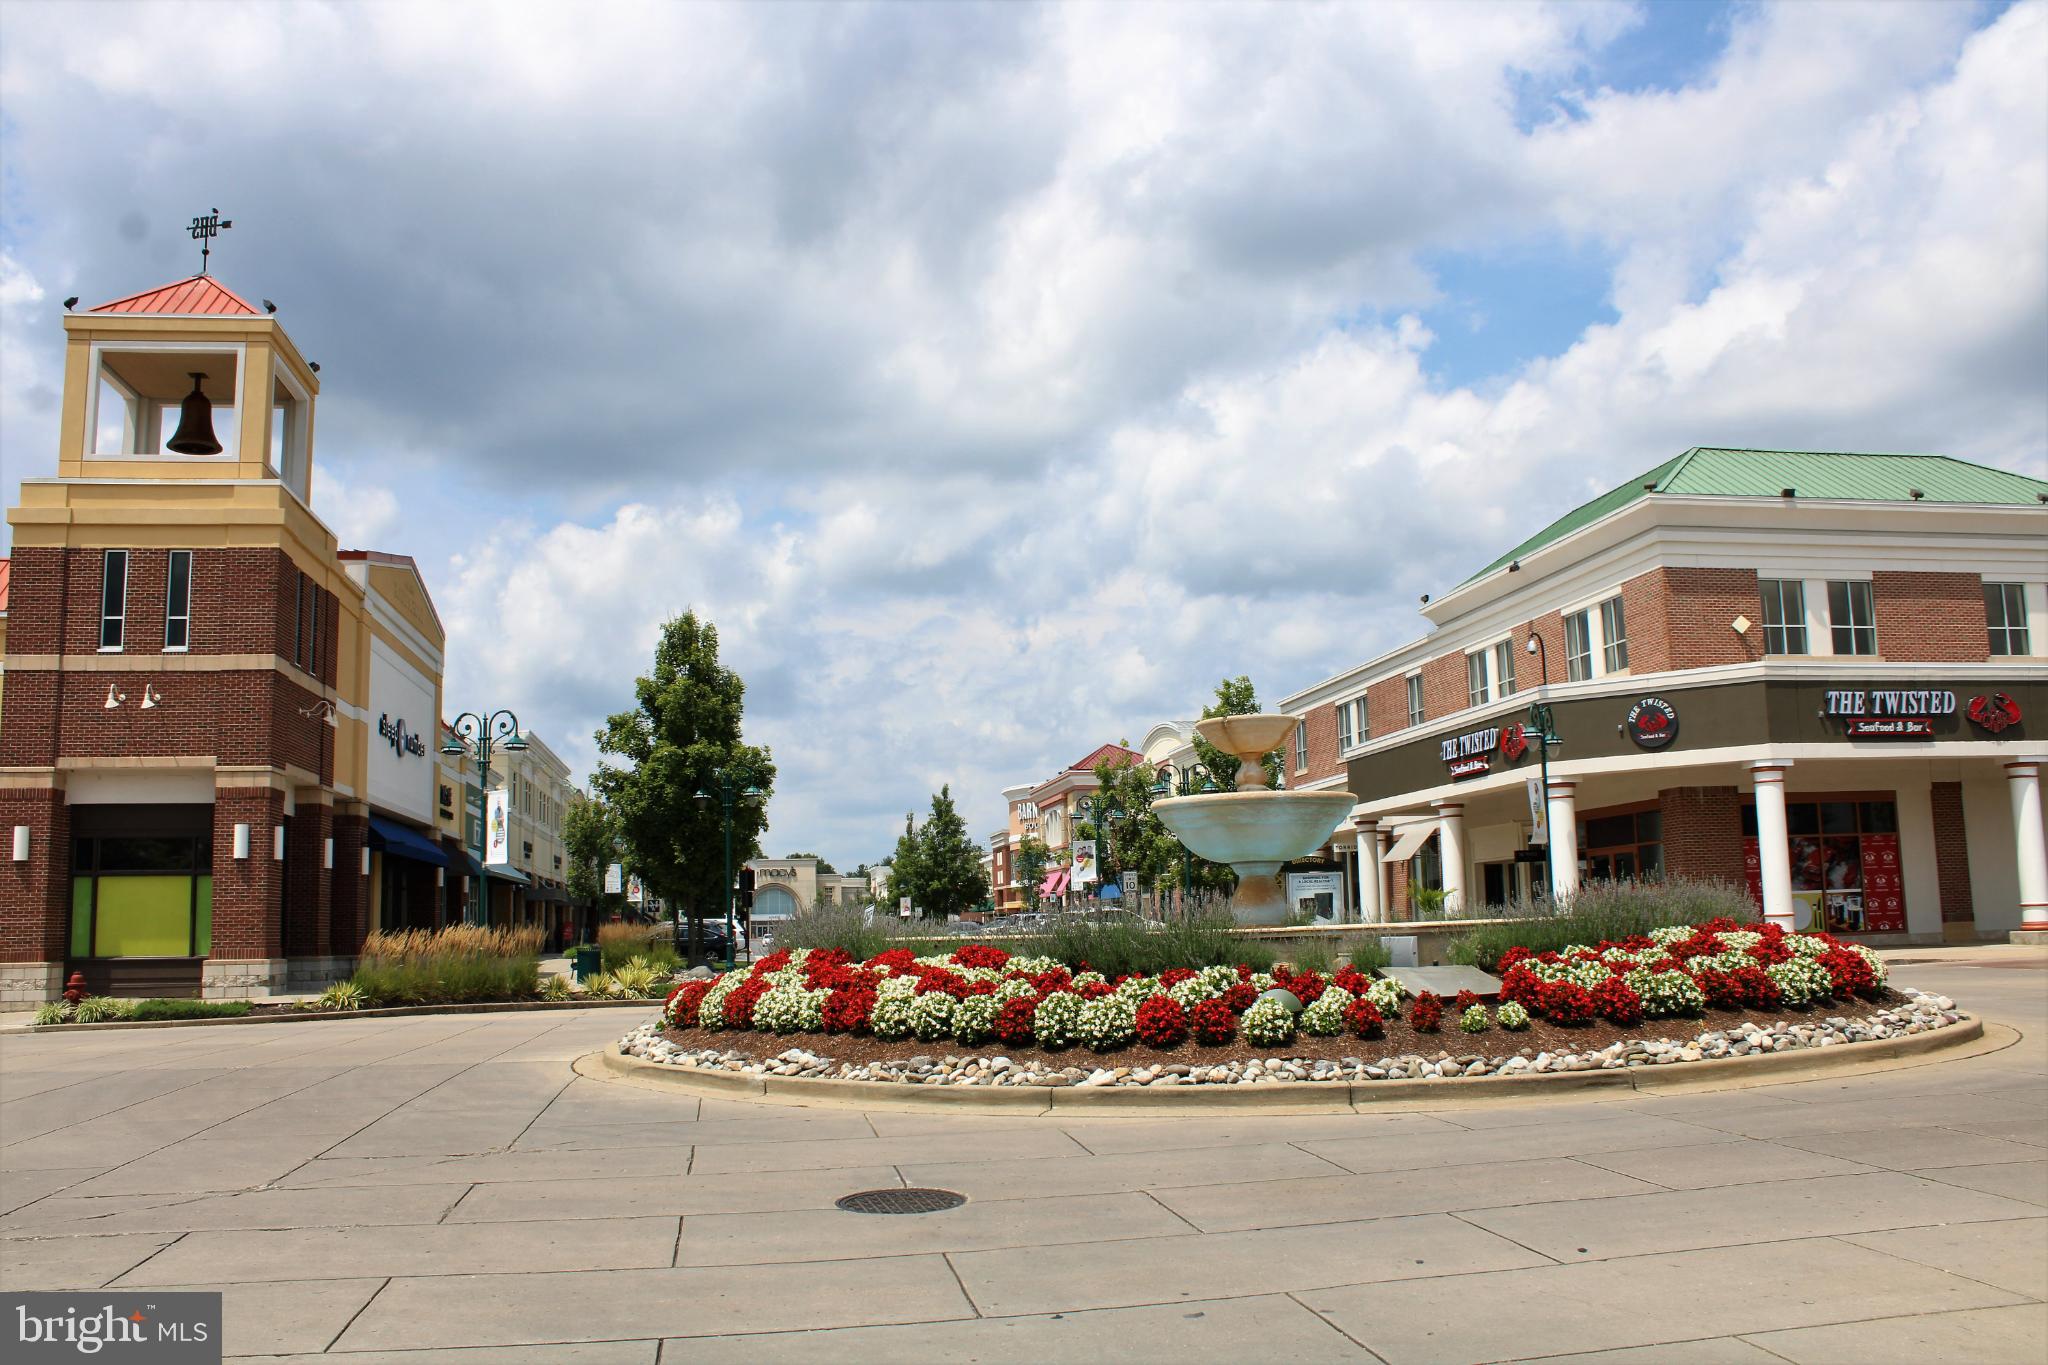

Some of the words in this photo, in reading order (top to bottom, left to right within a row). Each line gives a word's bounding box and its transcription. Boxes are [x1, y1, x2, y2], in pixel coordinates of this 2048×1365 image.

[1628, 705, 1640, 723] THE
[1640, 698, 1675, 719] TWISTED
[1827, 691, 1865, 714] THE
[1872, 691, 1956, 714] TWISTED
[1858, 721, 1895, 732] Seafood
[1896, 721, 1904, 732] &
[1906, 721, 1923, 732] Bar
[1441, 738, 1458, 761] THE
[1460, 728, 1497, 756] TWISTED
[1290, 857, 1325, 865] DIRECTORY
[1126, 881, 1136, 889] 10
